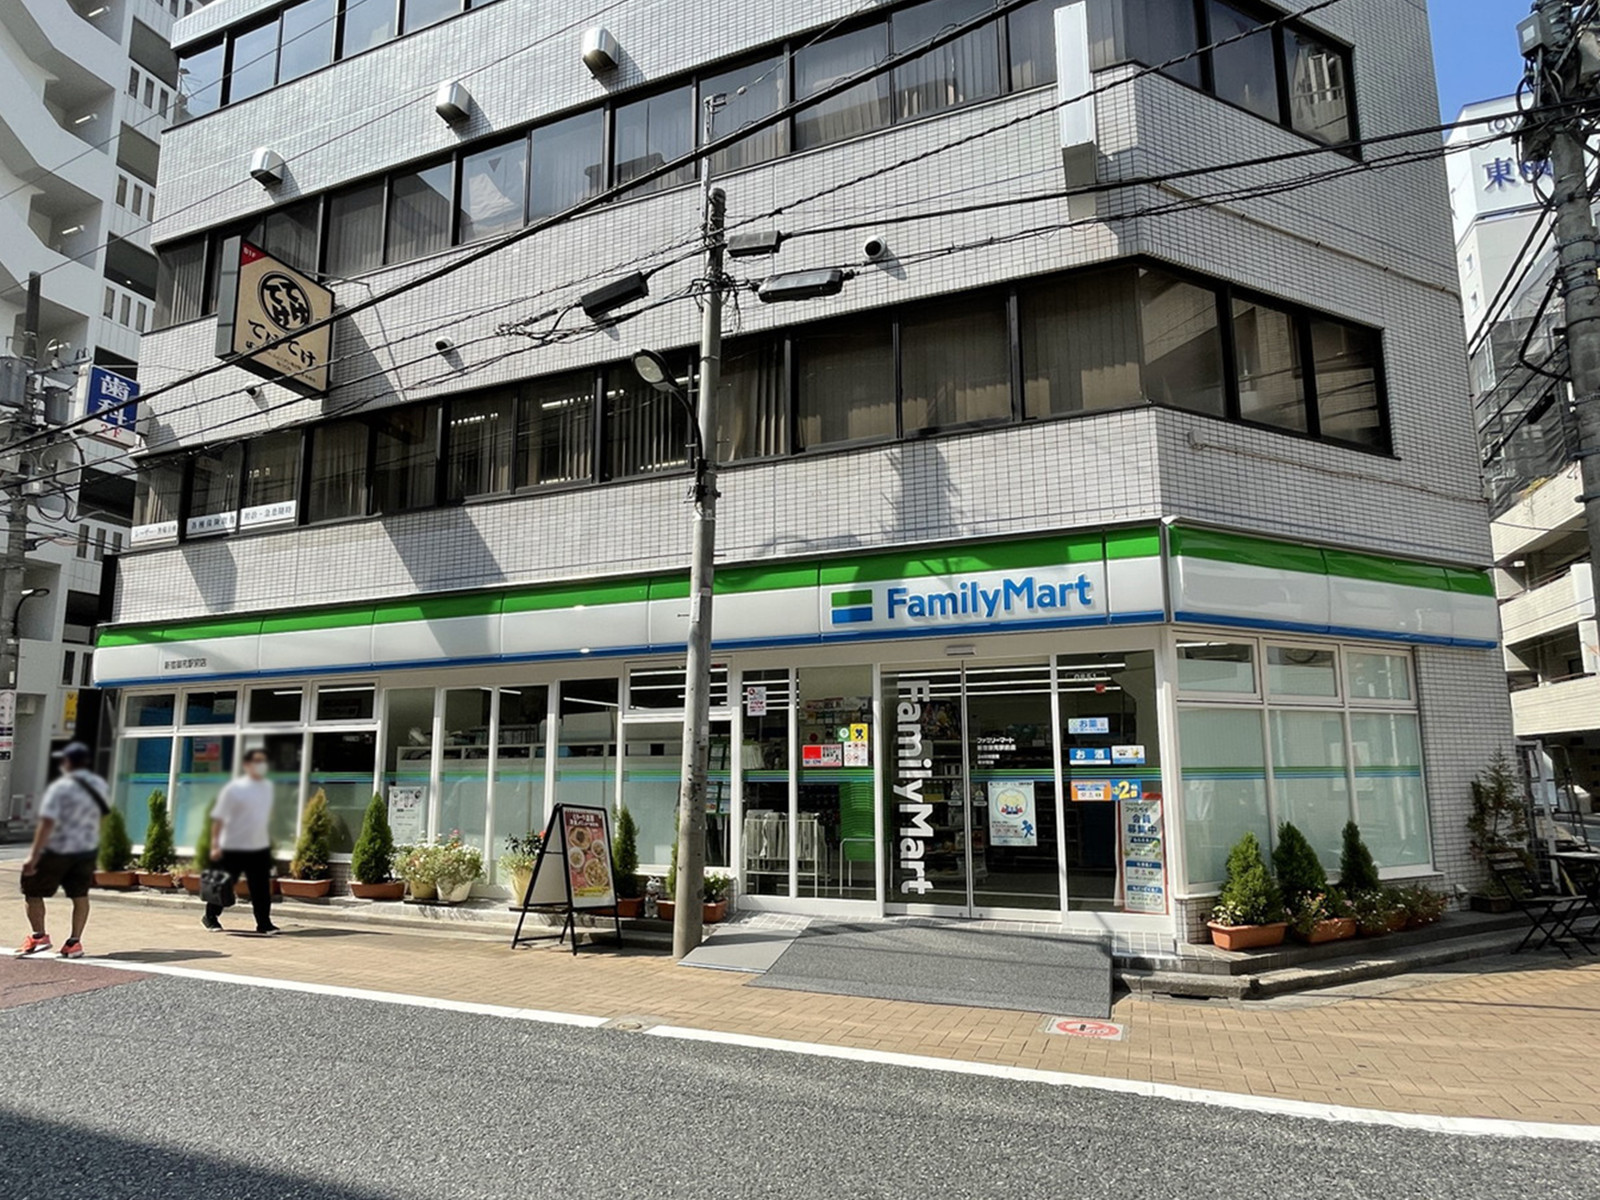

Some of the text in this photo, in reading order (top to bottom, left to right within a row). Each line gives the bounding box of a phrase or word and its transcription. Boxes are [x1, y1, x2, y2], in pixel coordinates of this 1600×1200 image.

[96, 375, 131, 425] 歯科
[887, 574, 1092, 619] FamilyMart
[893, 680, 934, 894] FamilyMart
